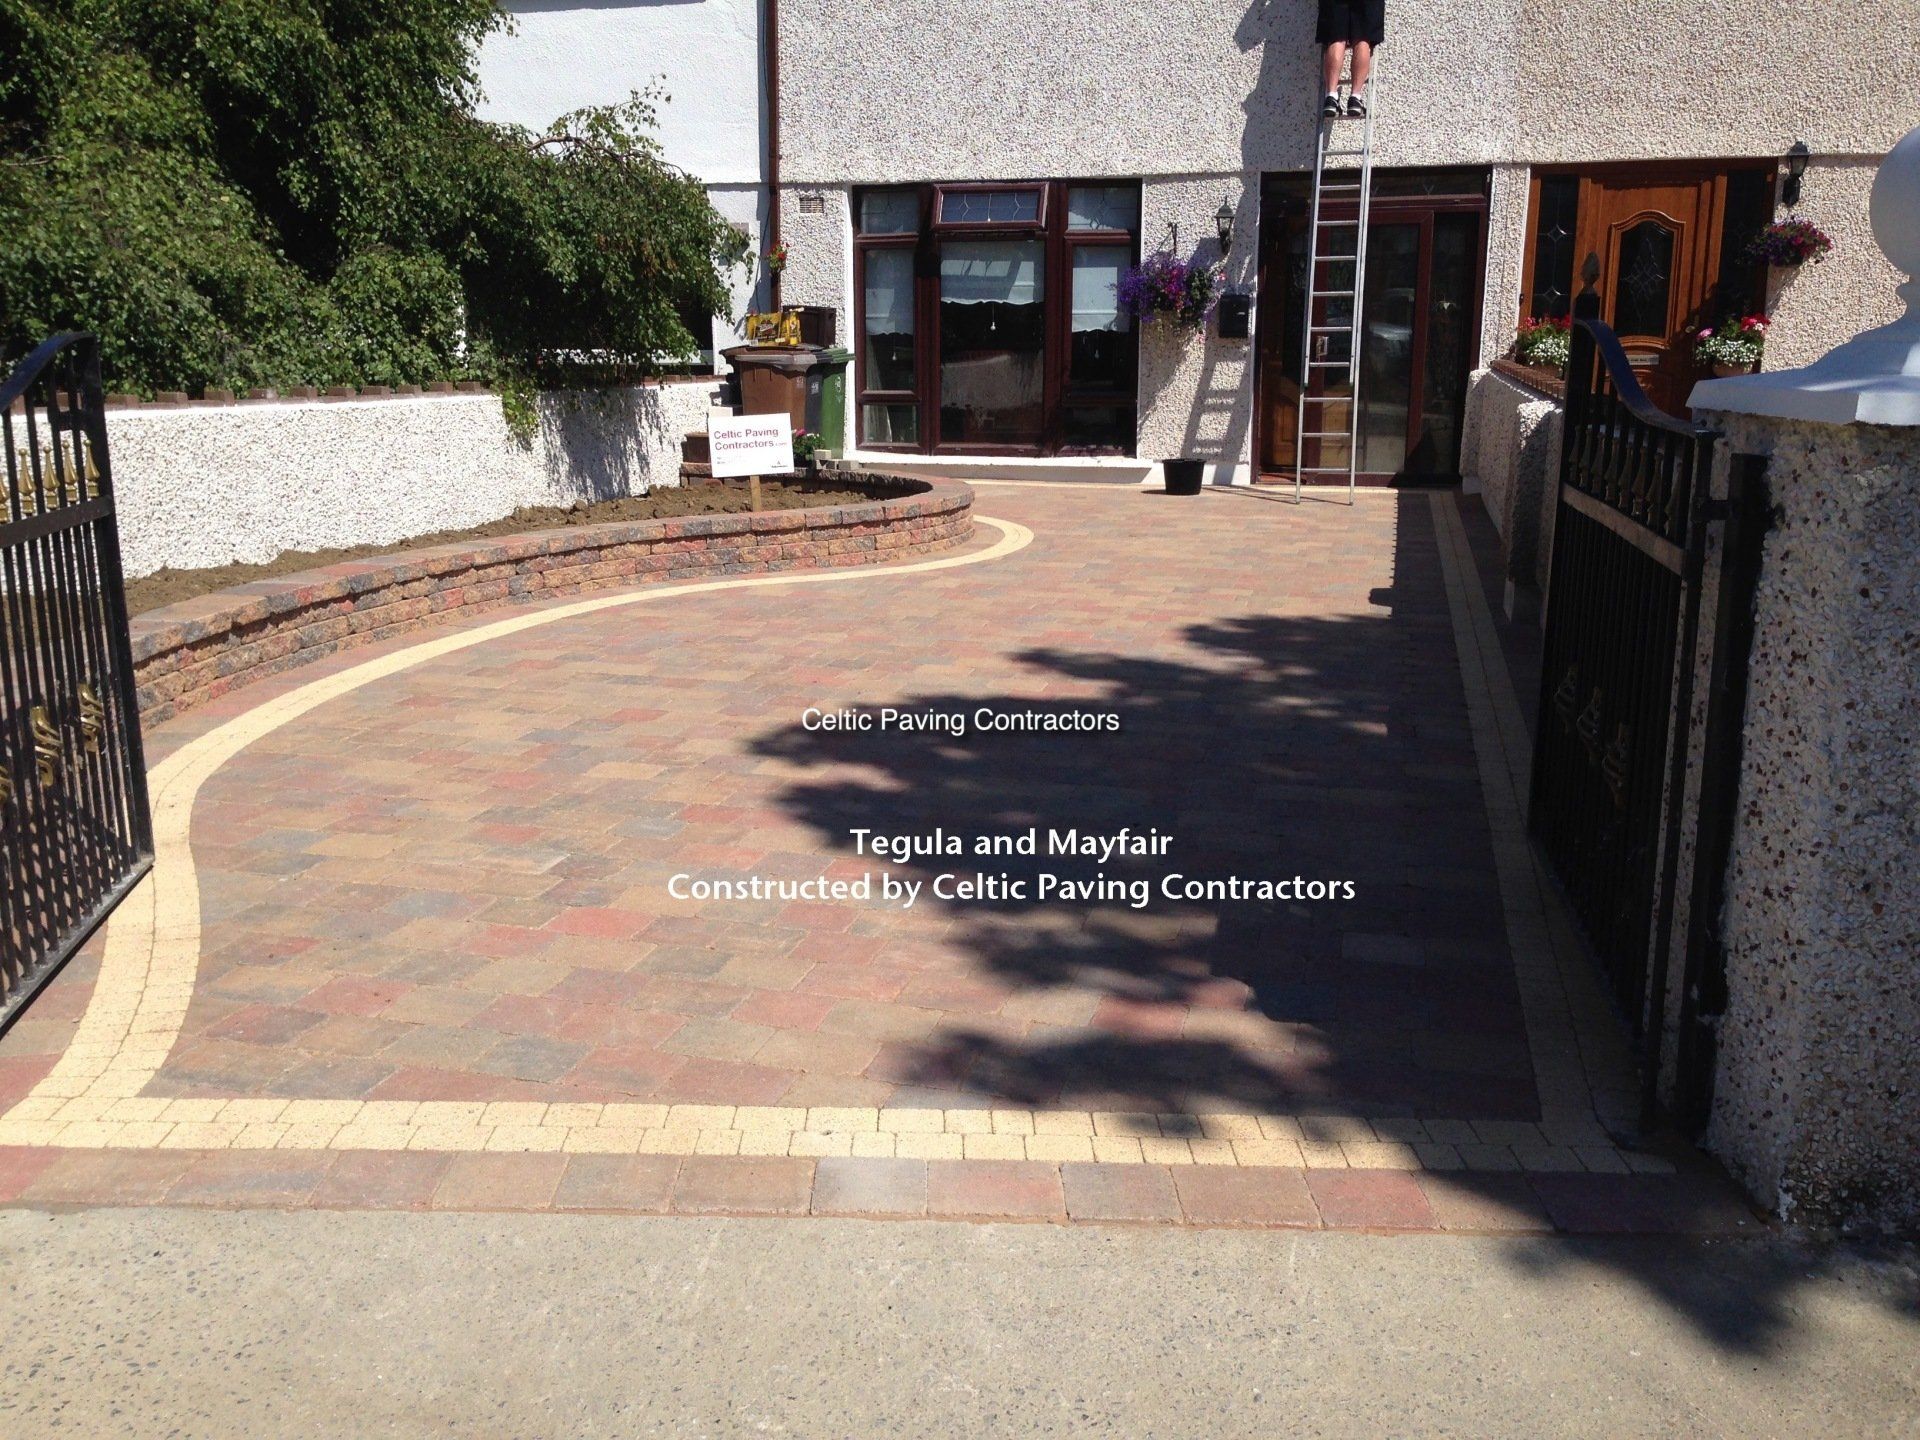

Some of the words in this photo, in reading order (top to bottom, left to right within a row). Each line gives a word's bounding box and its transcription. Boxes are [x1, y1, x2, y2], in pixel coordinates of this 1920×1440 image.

[713, 430, 742, 439] Celtic
[745, 429, 779, 437] Paving
[714, 440, 774, 450] Contractors
